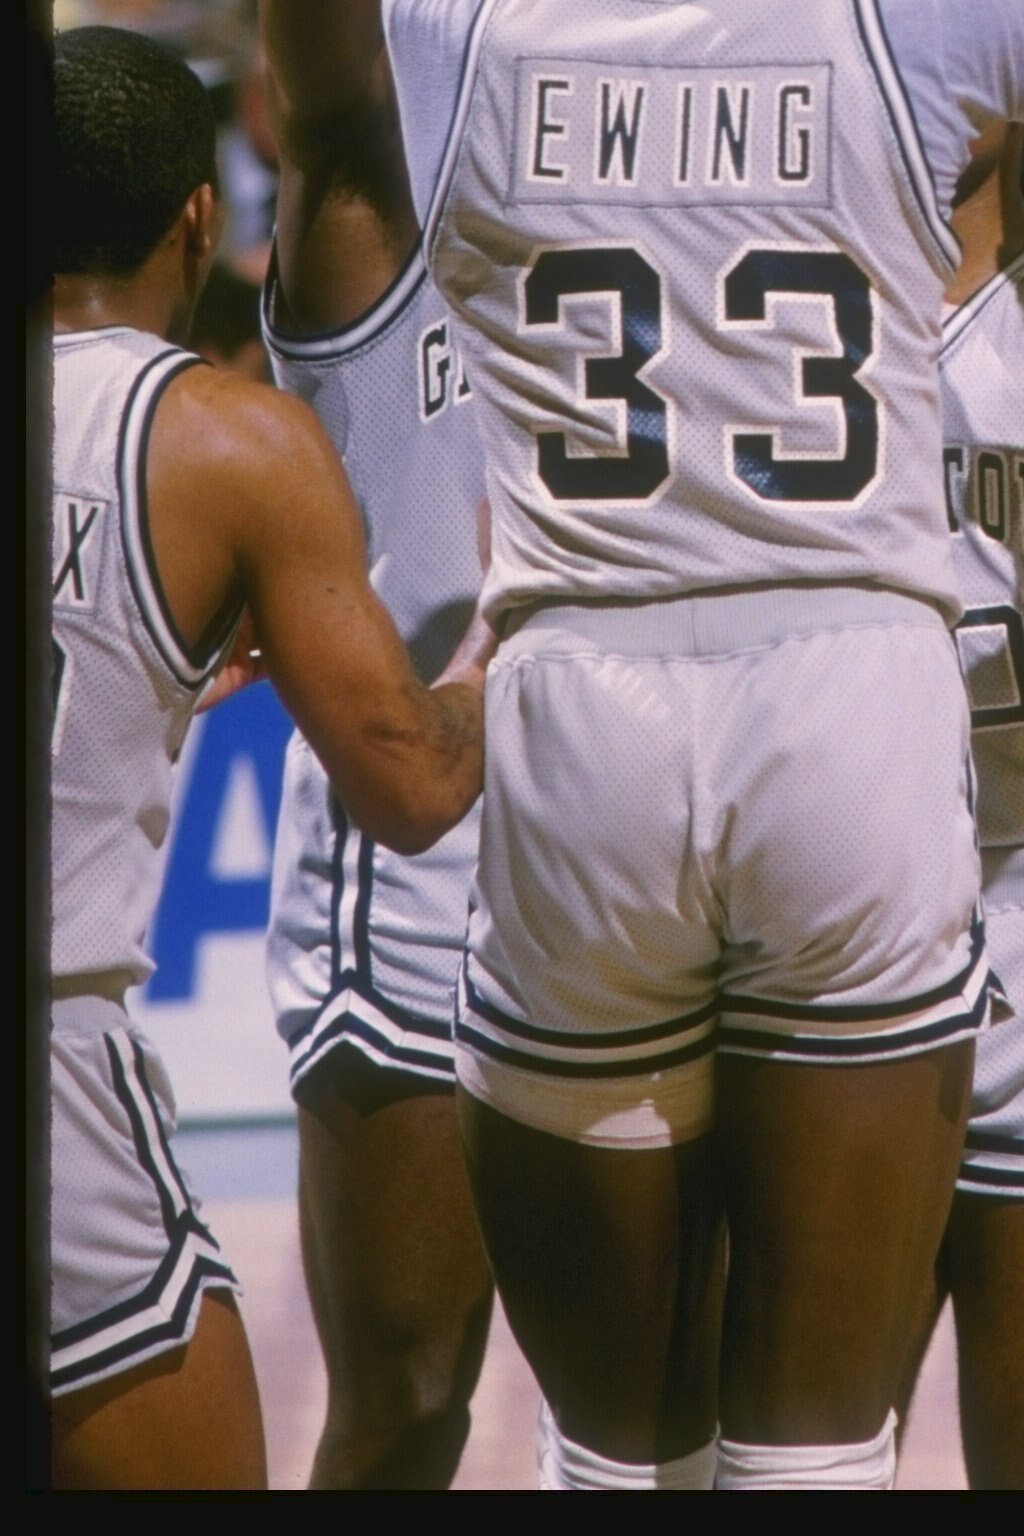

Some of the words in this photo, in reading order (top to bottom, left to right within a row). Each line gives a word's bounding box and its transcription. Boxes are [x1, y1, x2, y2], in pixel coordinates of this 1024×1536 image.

[526, 74, 814, 186] EWING
[418, 316, 473, 422] G
[517, 240, 882, 509] 33
